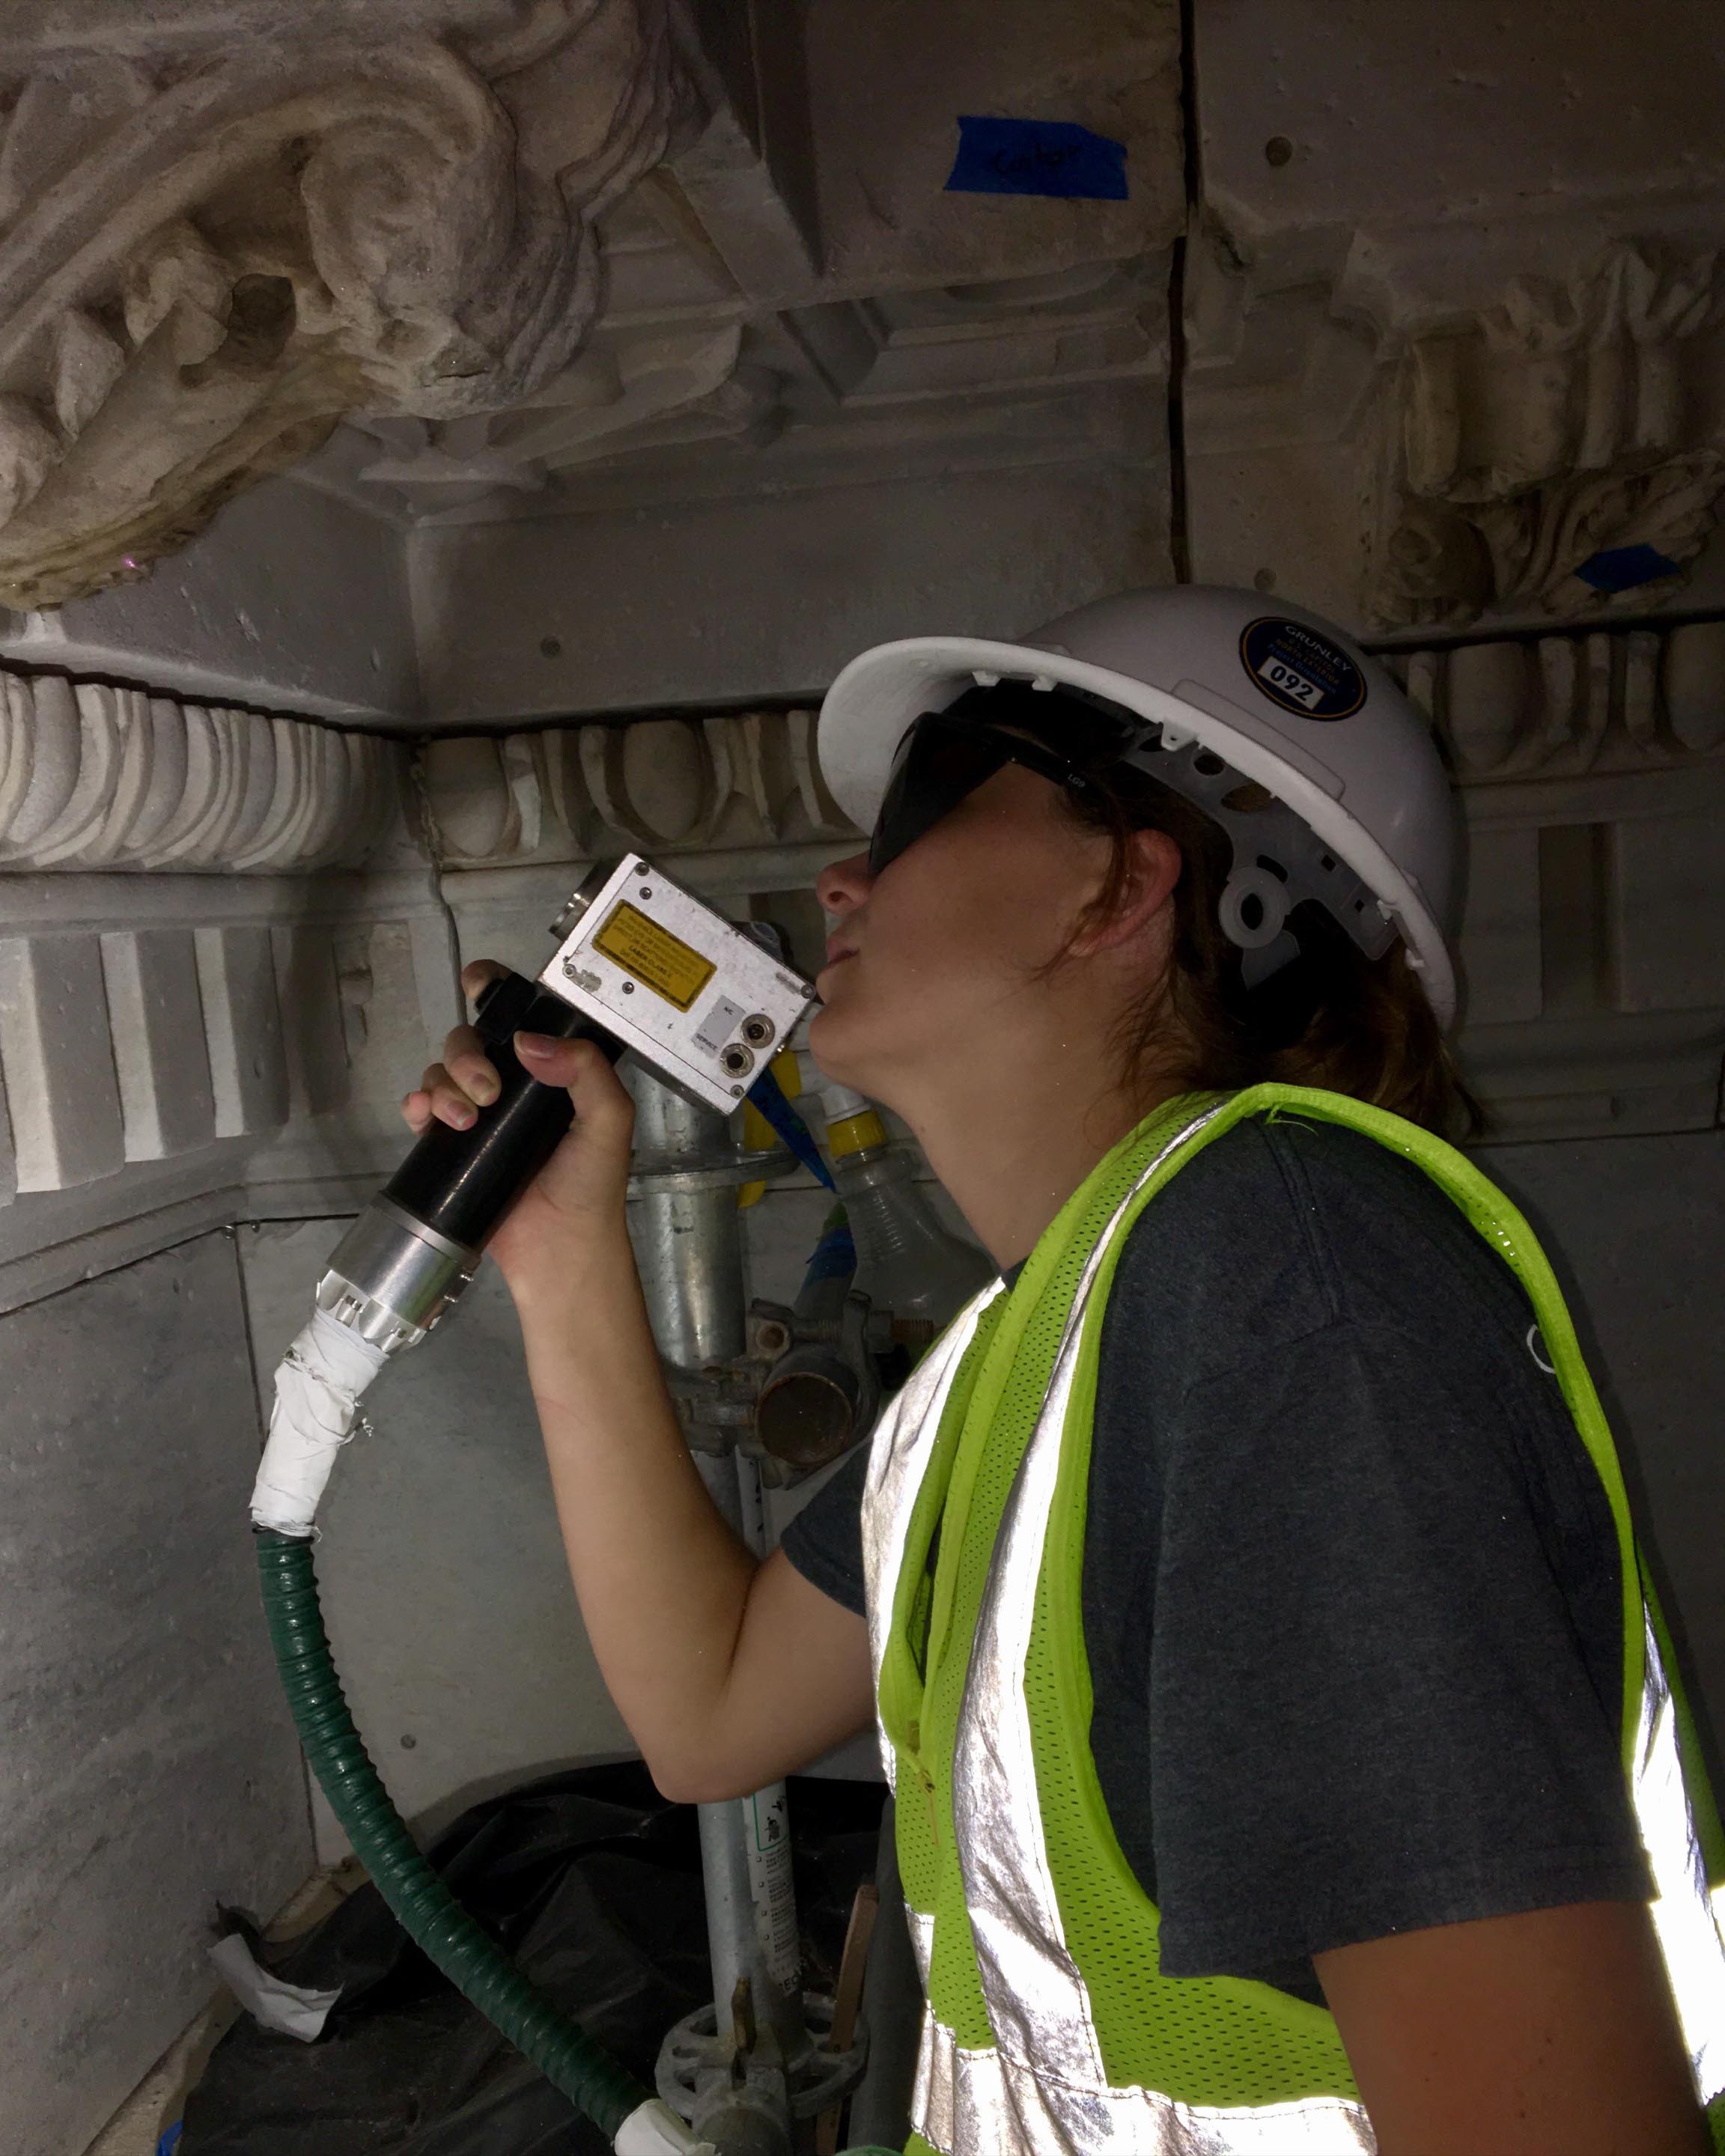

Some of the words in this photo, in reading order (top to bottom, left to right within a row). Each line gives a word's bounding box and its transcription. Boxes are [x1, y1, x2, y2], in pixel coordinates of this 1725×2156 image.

[1284, 625, 1353, 672] GRUNLEY
[1271, 666, 1313, 701] 092
[696, 1033, 718, 1050] SERVICE
